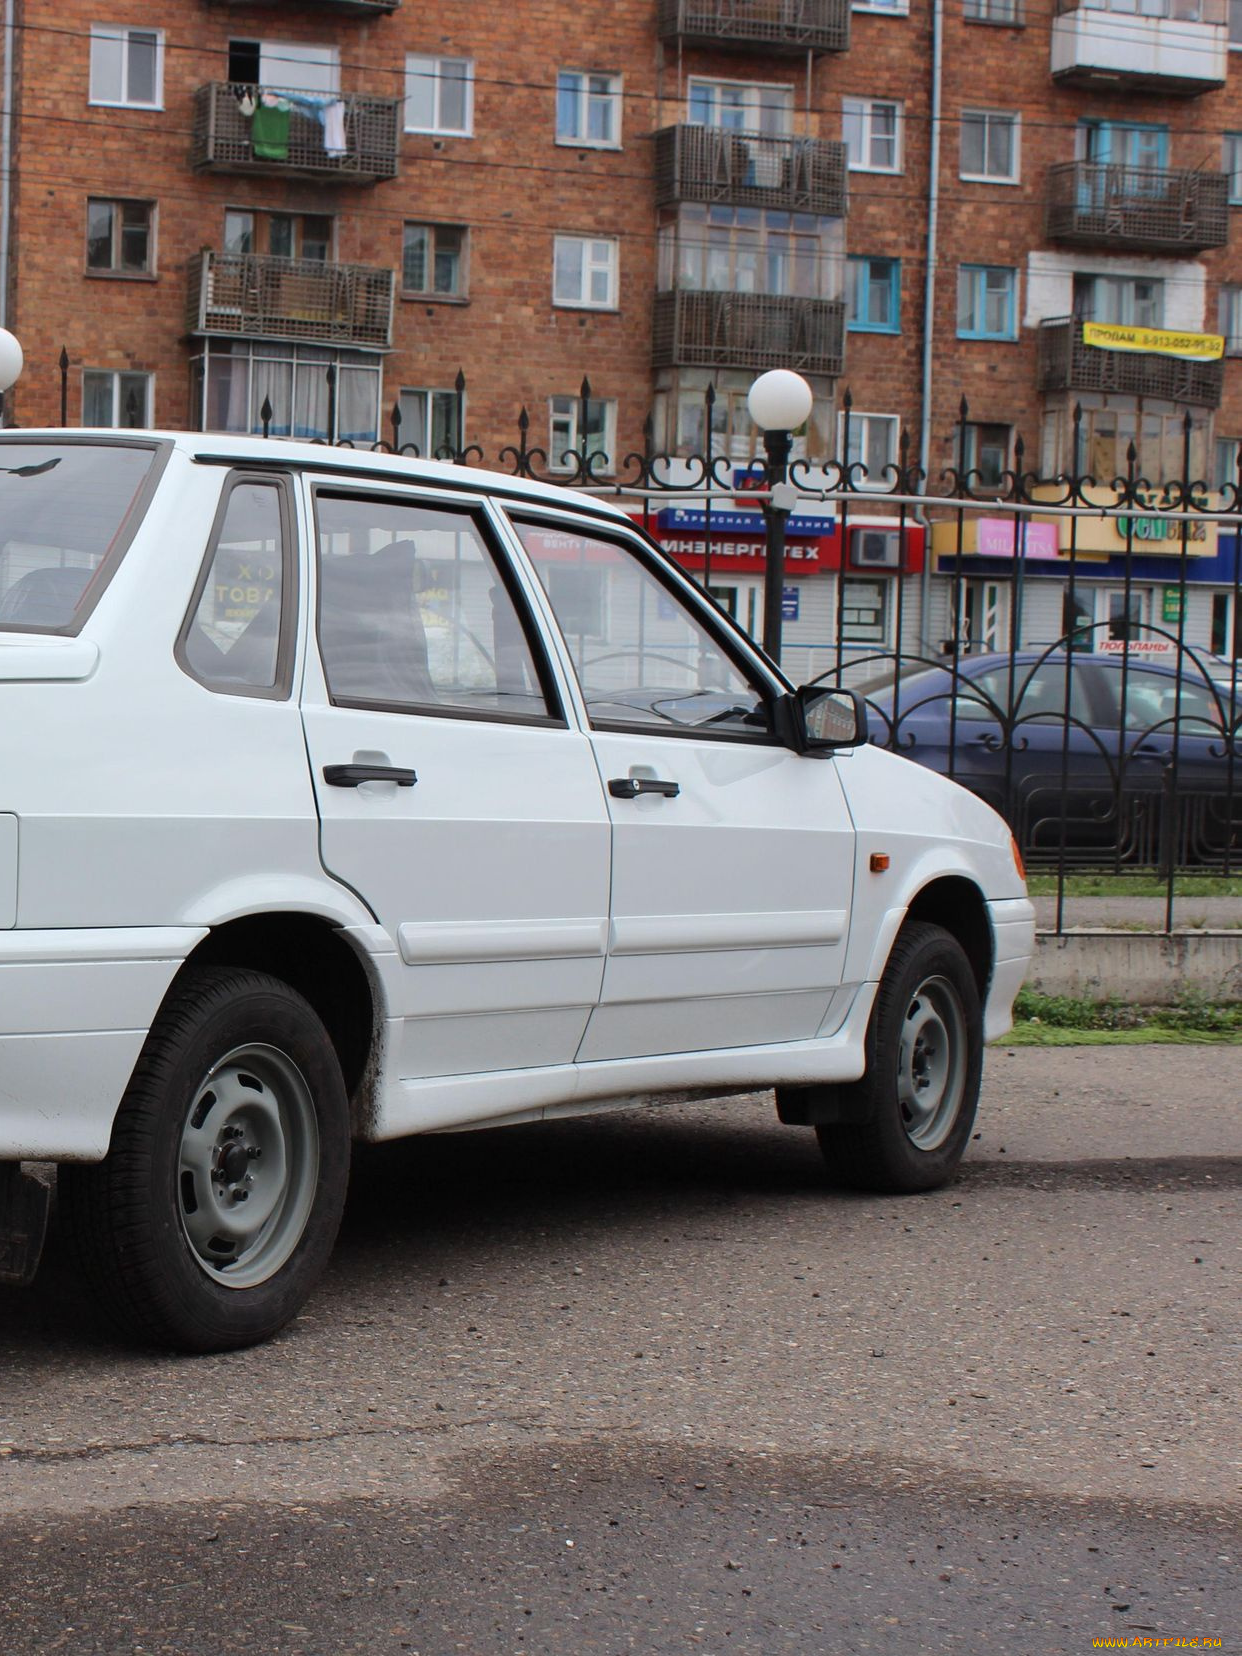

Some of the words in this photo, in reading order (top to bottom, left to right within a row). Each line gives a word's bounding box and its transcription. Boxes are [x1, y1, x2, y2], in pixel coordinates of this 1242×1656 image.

[1089, 327, 1136, 342] ПРОДАМ
[760, 518, 830, 529] КПАНИЯ
[659, 539, 820, 560] ИНЭНЕРГТЕХ
